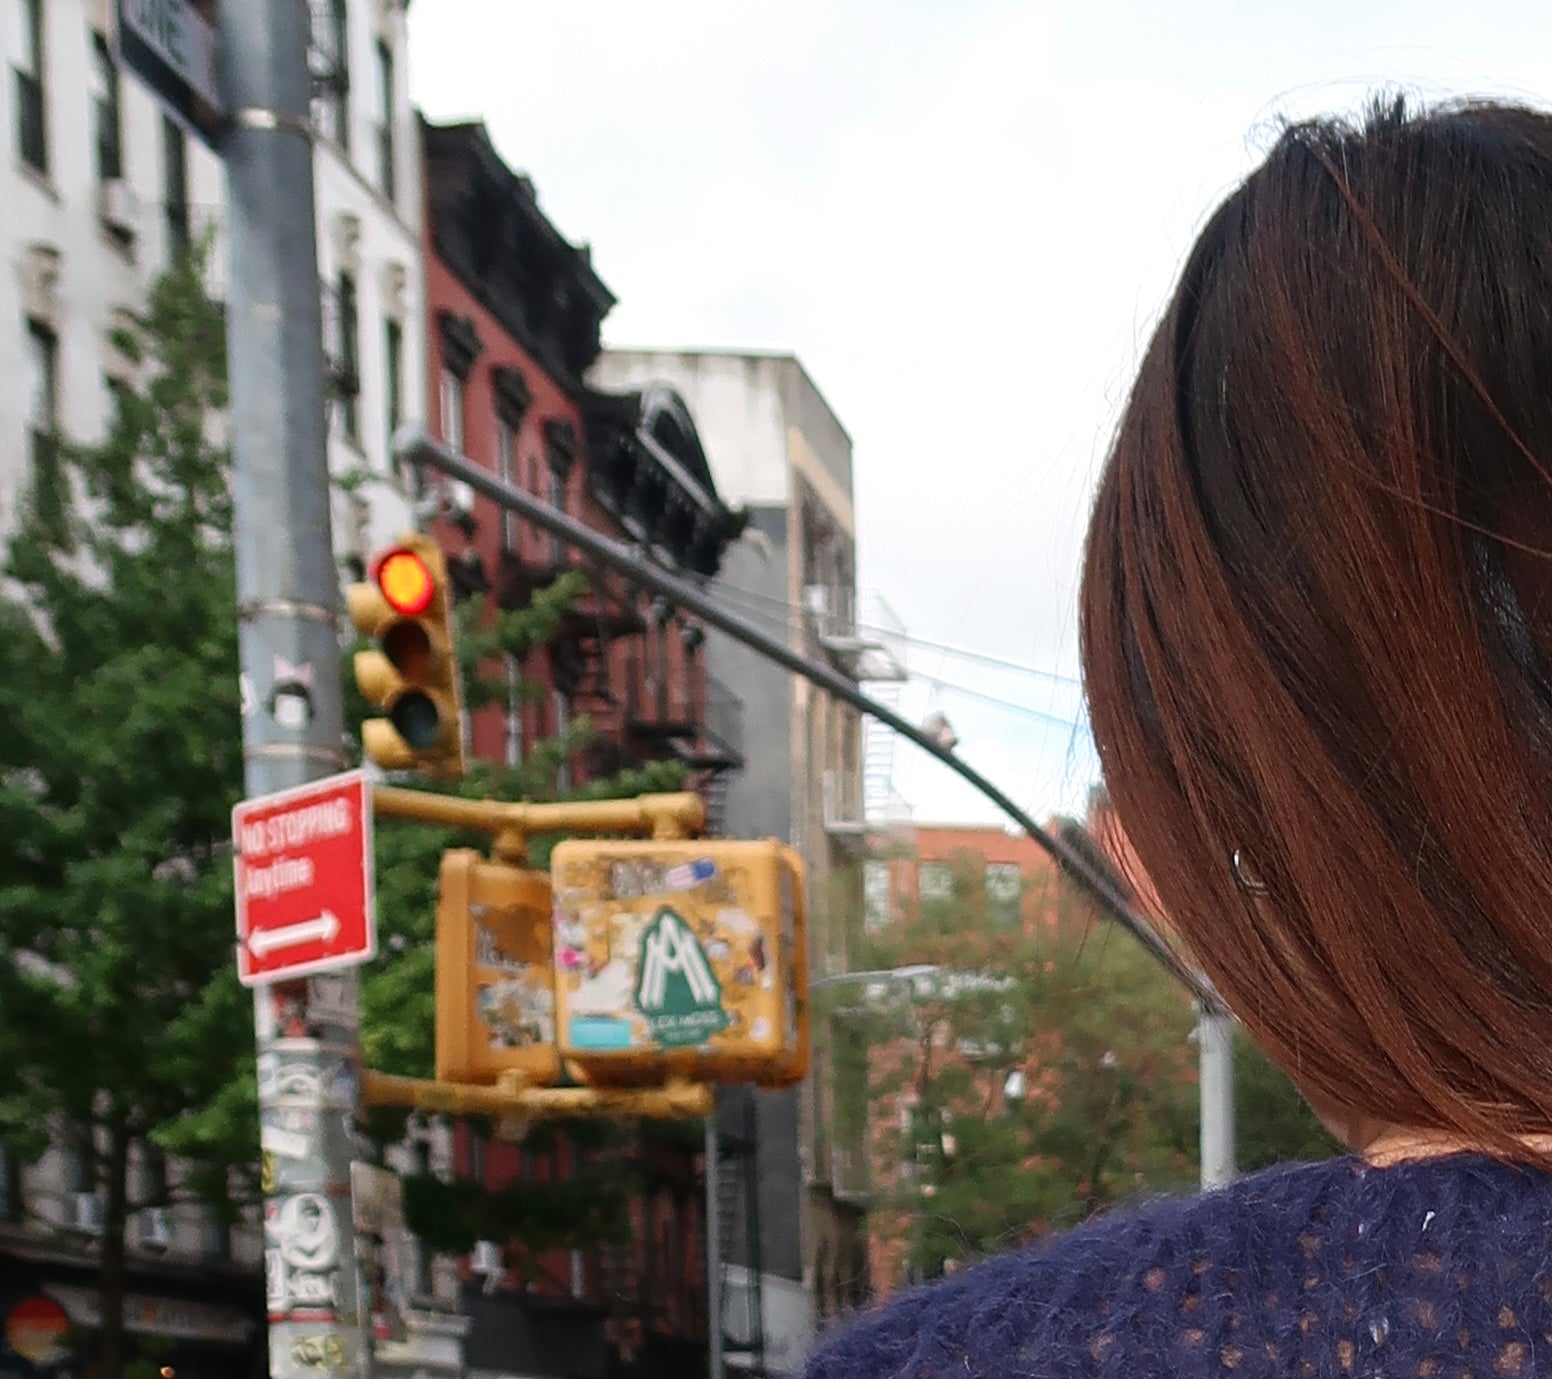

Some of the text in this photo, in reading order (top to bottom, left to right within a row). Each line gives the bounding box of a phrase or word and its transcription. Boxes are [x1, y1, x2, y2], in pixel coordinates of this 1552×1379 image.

[242, 797, 351, 856] NO STOPPING
[246, 856, 314, 900] Anytime
